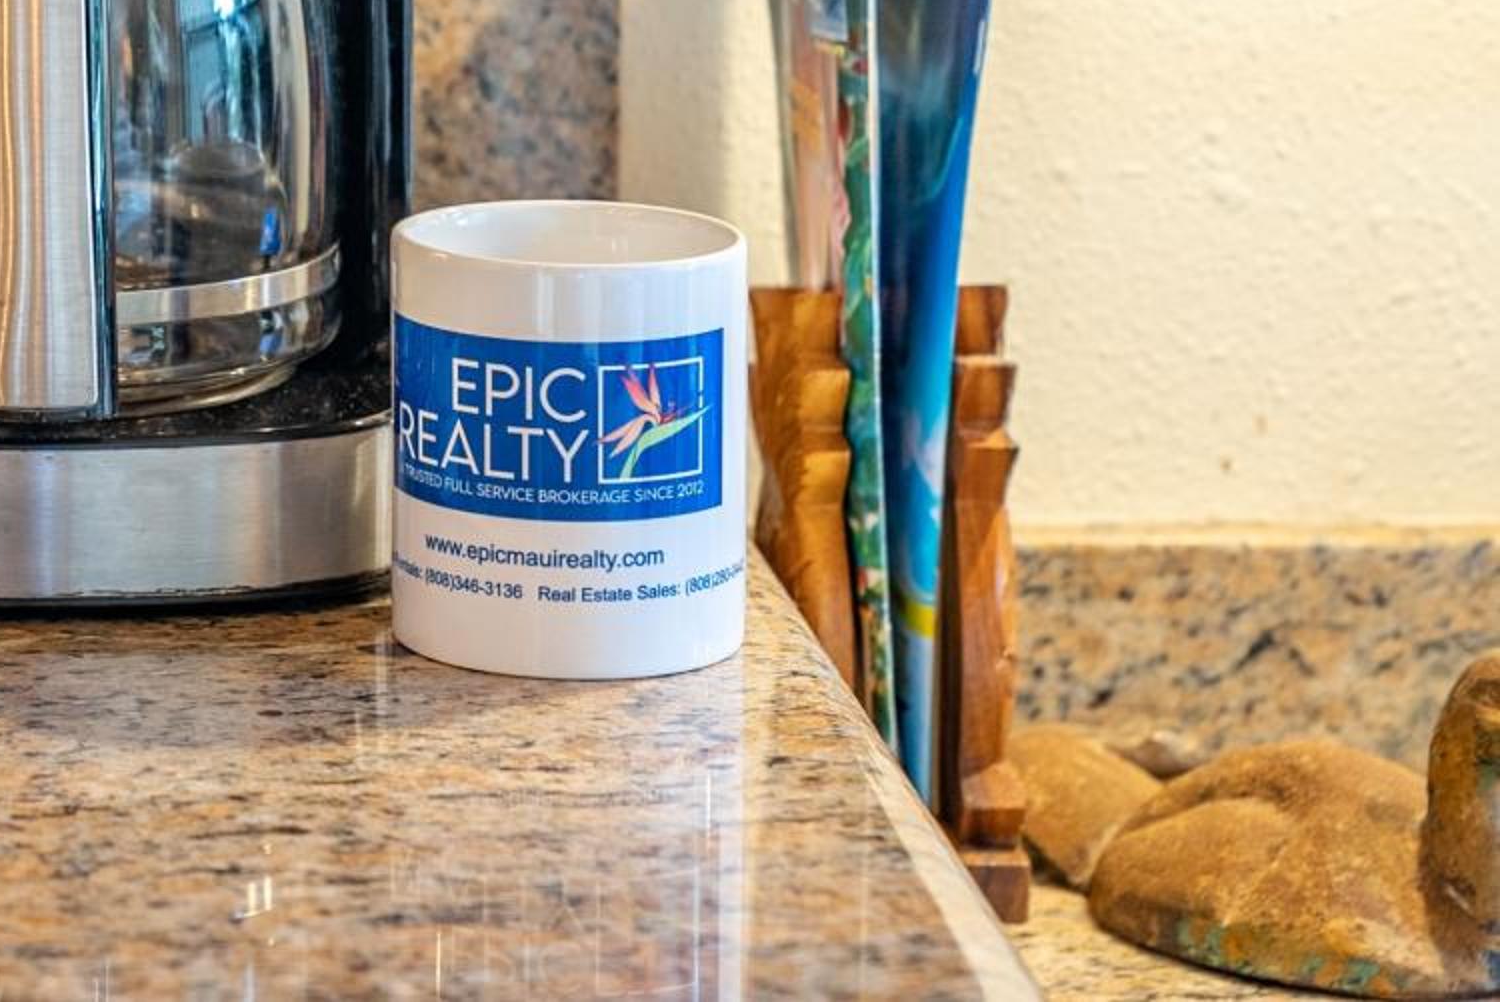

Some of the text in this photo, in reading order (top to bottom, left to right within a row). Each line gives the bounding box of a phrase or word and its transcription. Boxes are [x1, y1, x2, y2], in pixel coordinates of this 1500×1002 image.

[451, 357, 586, 423] EPIC
[399, 400, 589, 484] REALTY
[443, 477, 473, 495] FULL
[476, 483, 534, 502] SERVICE
[537, 488, 630, 504] BROKERAGE
[634, 485, 674, 502] SINCE
[677, 480, 704, 498] 2012
[424, 534, 665, 573] www.epicmauirealty.com
[425, 567, 523, 599] (808)346-3136
[538, 586, 576, 602] Real
[582, 586, 632, 602] Estate
[637, 583, 681, 600] Sales:
